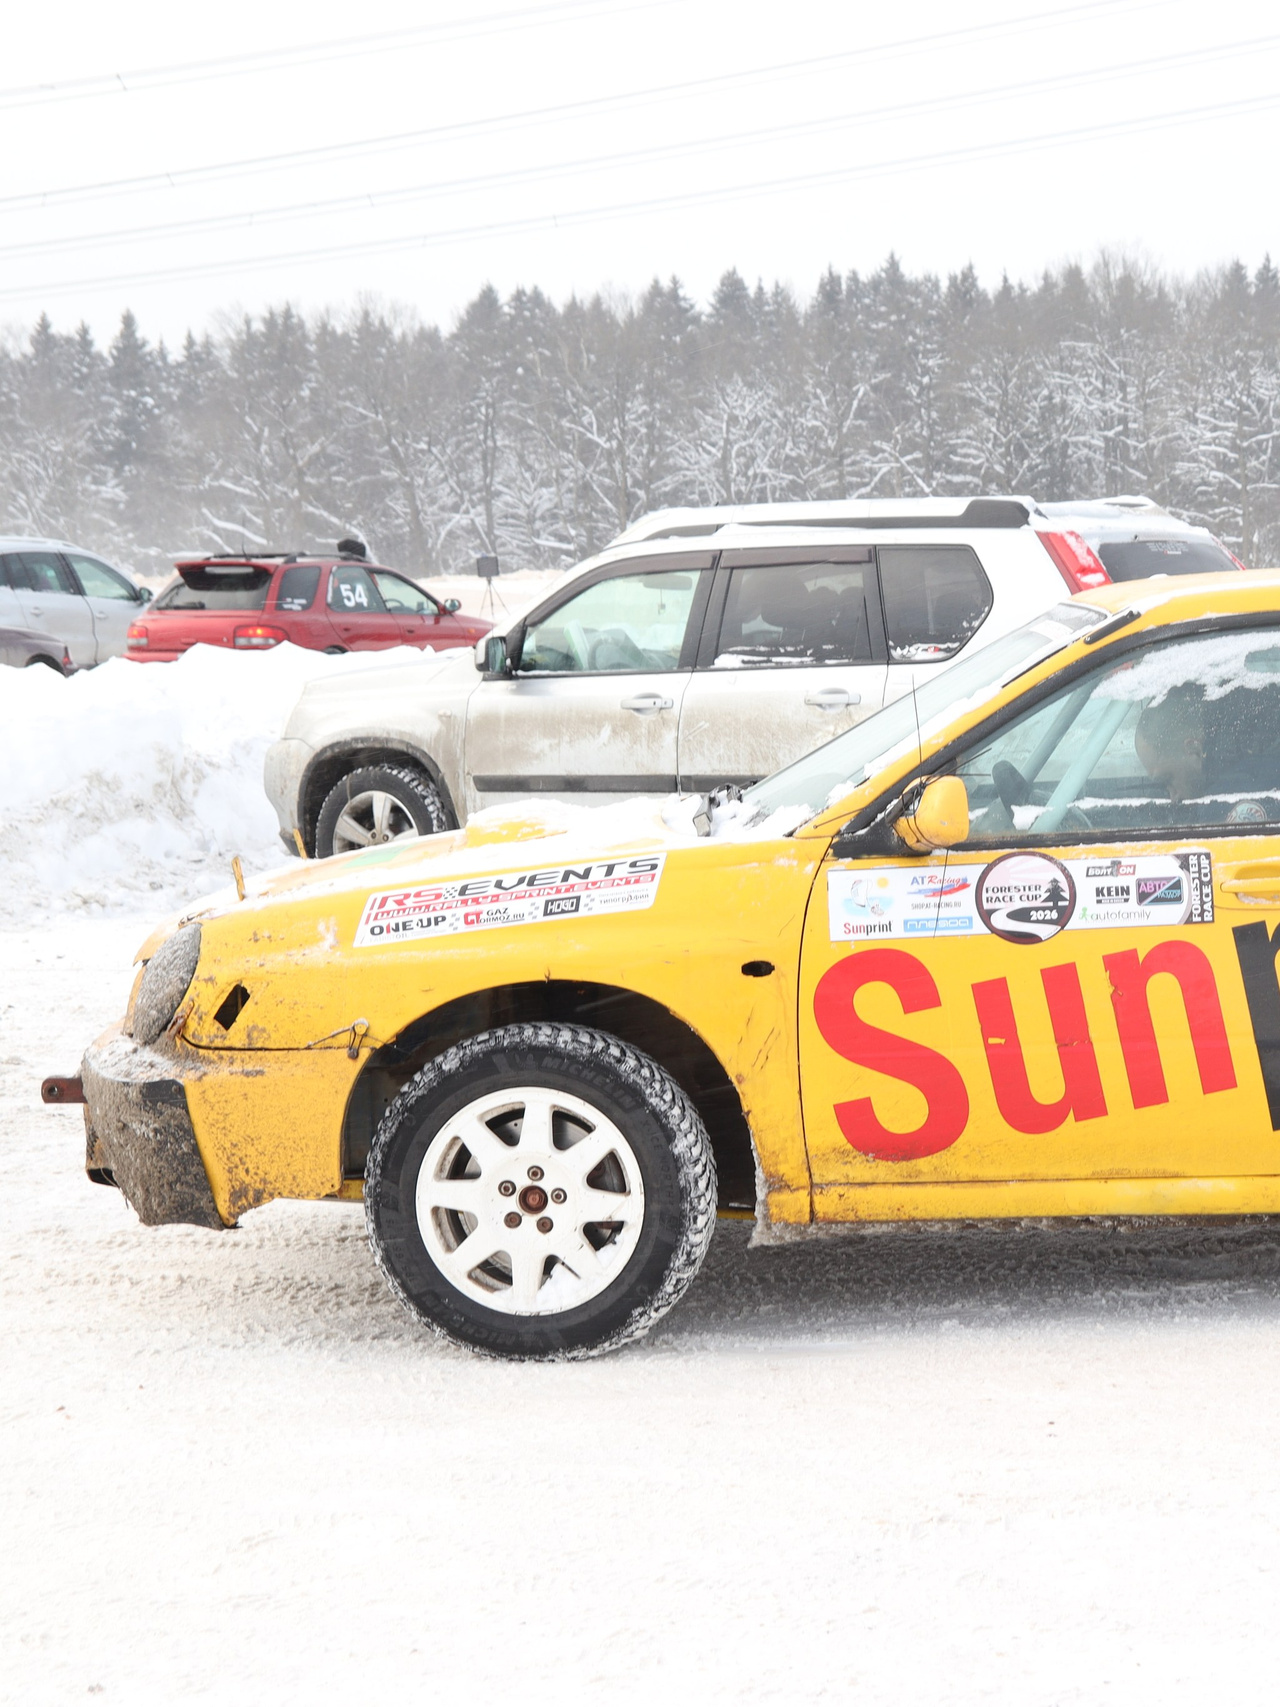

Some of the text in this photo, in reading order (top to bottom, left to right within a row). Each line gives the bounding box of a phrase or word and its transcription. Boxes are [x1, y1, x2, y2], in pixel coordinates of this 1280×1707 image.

[339, 583, 368, 608] 54
[457, 857, 661, 897] EVENTS
[910, 874, 962, 888] AT Racing
[985, 884, 1042, 894] FORESTER
[1095, 885, 1131, 898] KEIN
[1188, 854, 1202, 922] FORESTER
[1200, 854, 1213, 922] RACE CUP
[985, 894, 1042, 904] RACE CUP
[1029, 909, 1058, 920] 2026
[1090, 908, 1152, 922] autofamily
[843, 920, 892, 936] Sunprint
